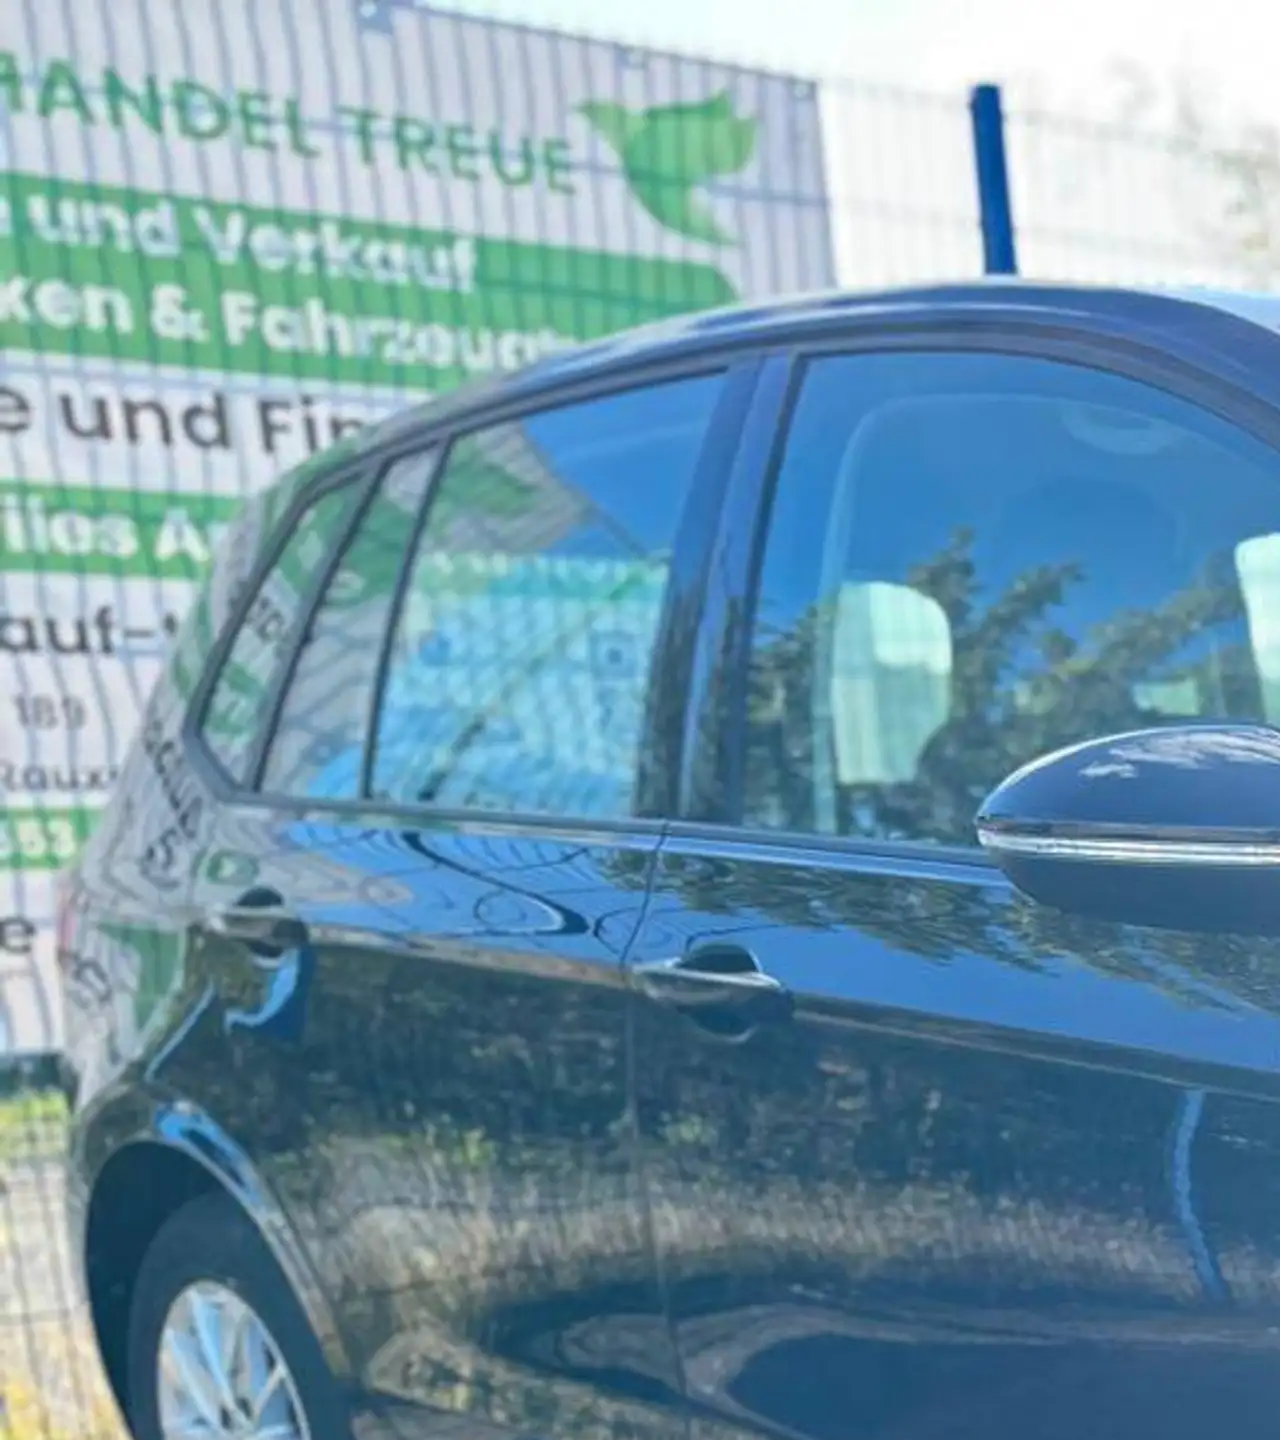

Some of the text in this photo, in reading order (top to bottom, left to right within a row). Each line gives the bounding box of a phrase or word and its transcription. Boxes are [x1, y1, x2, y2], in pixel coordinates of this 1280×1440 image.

[337, 104, 576, 195] TREUE
[27, 194, 181, 258] und
[191, 203, 476, 294] Verkauf
[152, 283, 210, 345] &
[58, 387, 231, 450] und
